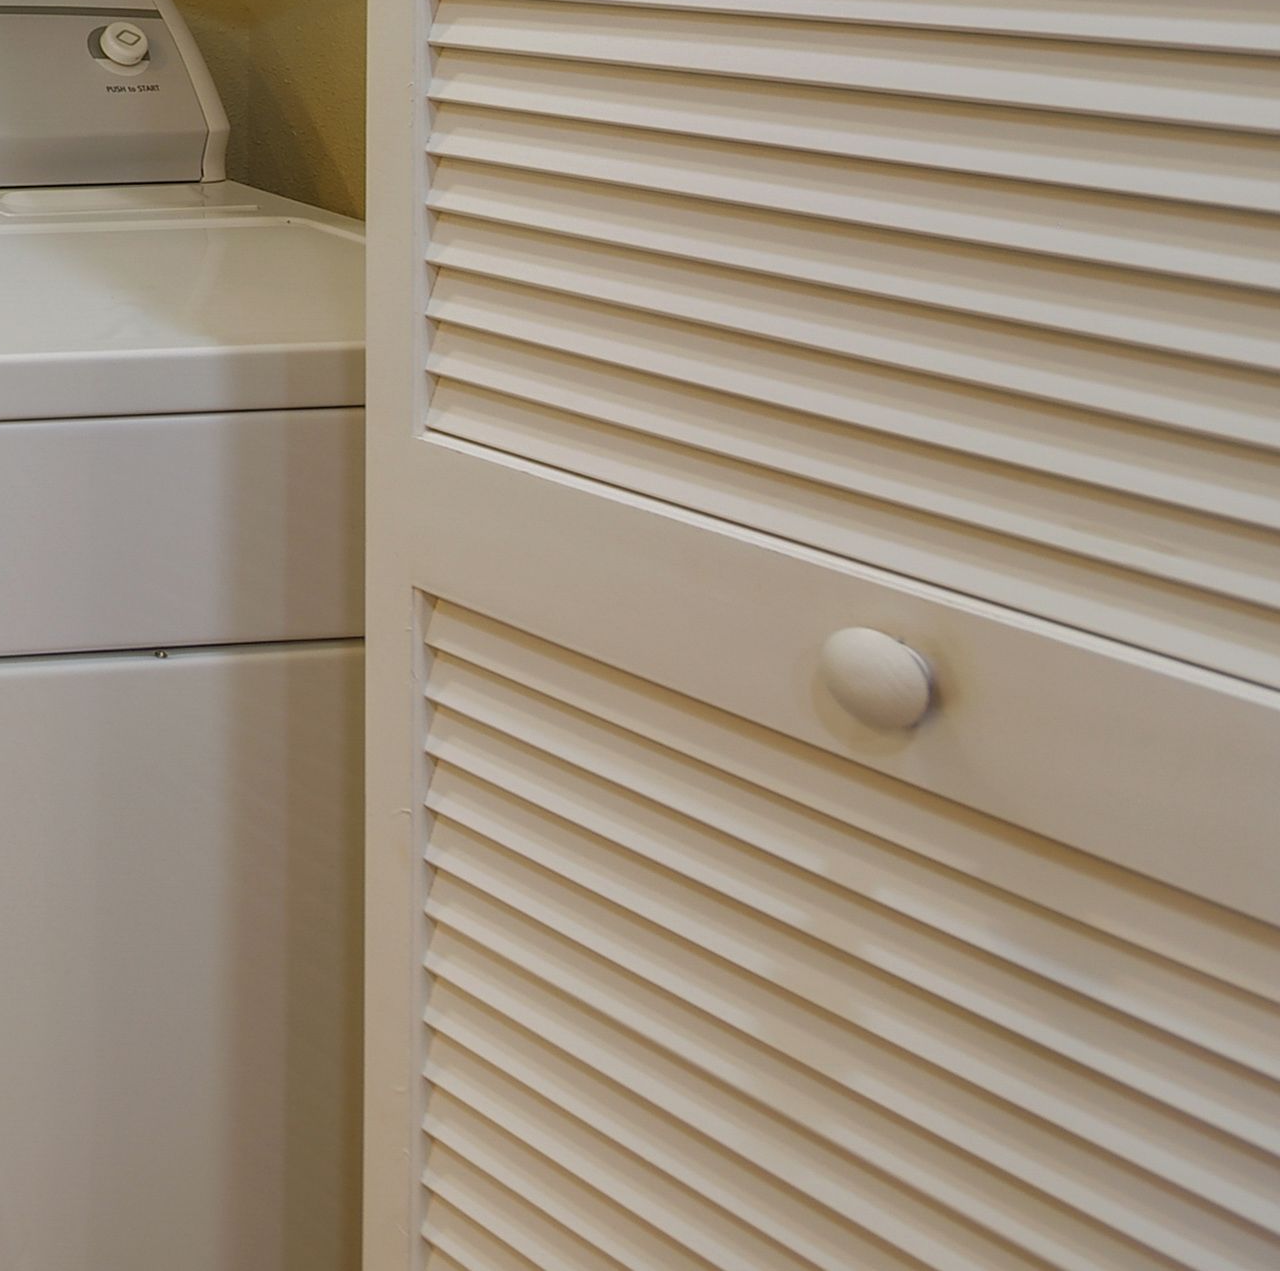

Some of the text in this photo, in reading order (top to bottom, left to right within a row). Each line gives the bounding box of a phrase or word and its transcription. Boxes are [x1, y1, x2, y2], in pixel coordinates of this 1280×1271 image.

[106, 84, 160, 93] PUSH to START
